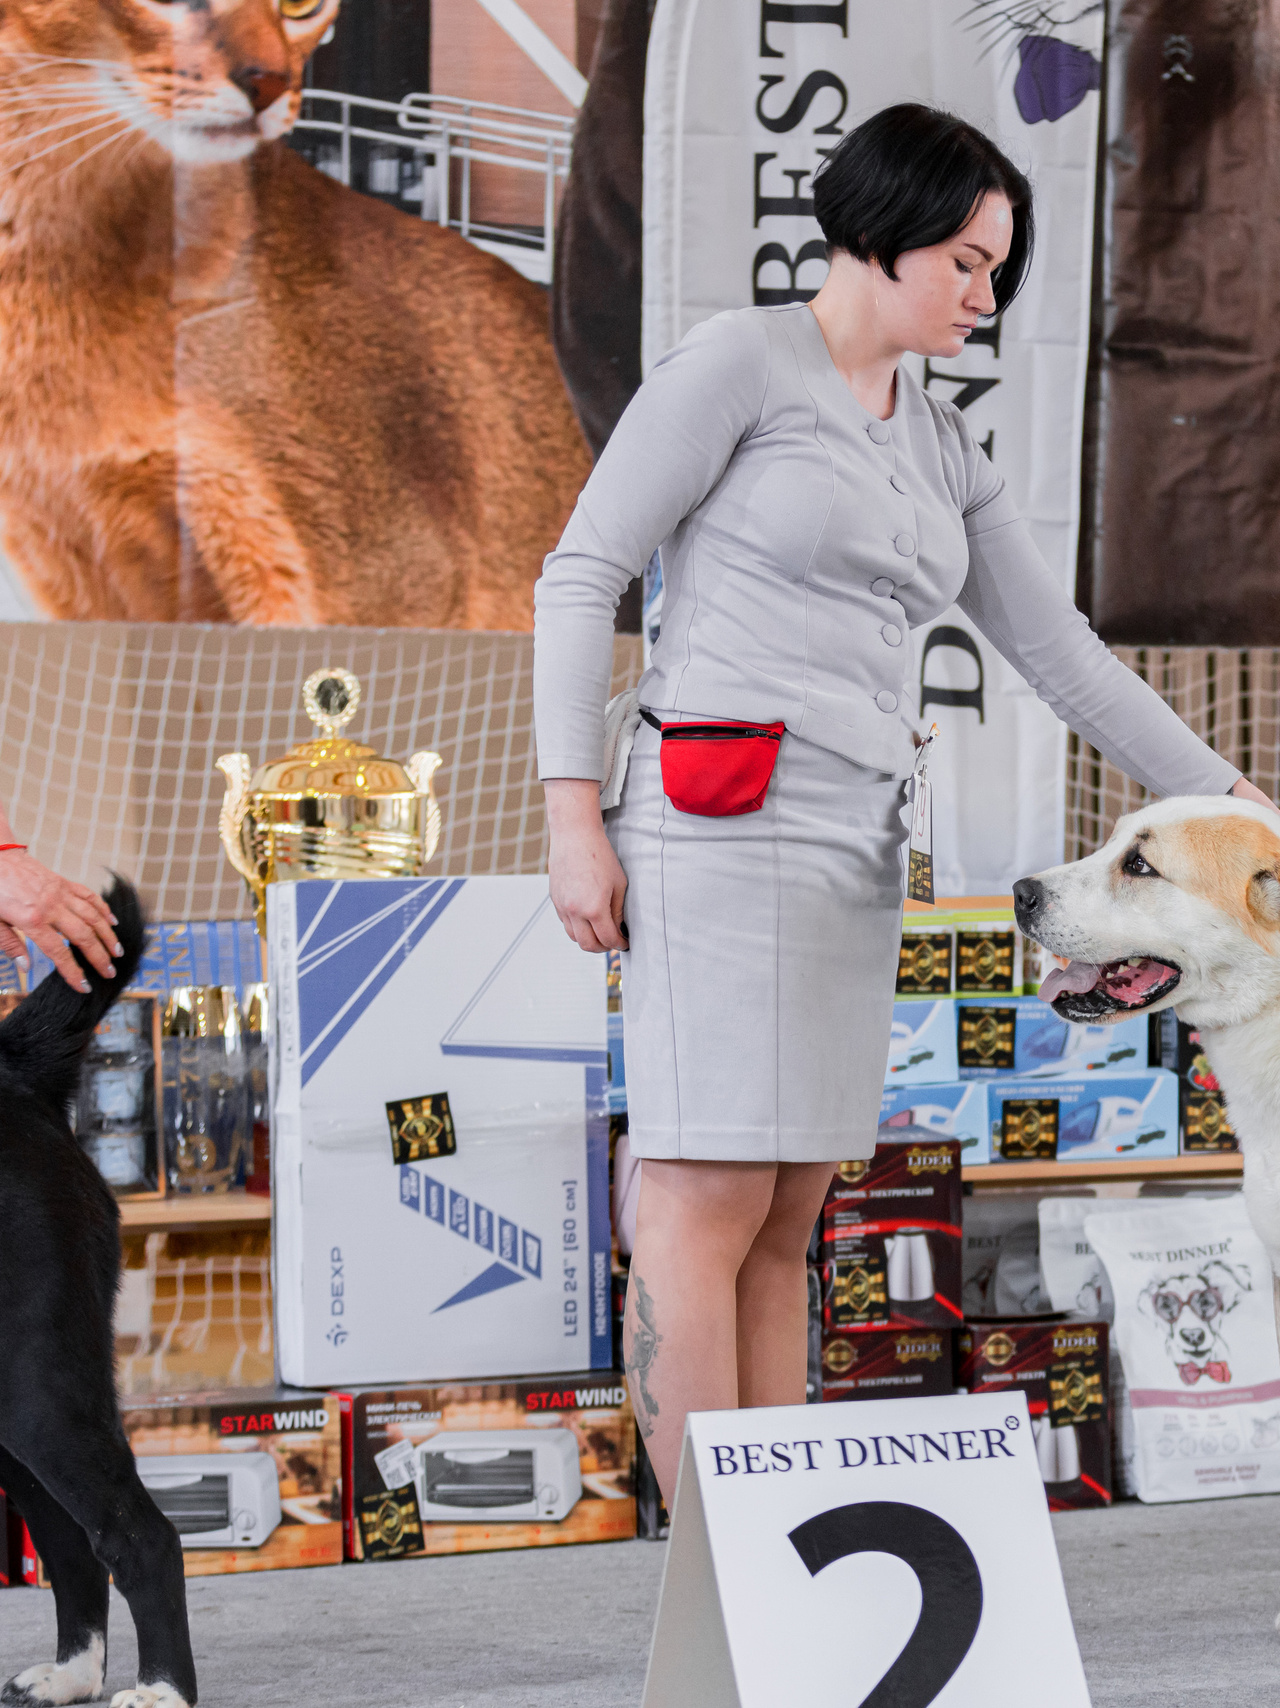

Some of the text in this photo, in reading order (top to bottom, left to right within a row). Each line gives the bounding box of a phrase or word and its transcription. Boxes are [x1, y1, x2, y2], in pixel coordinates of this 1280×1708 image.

[562, 1218, 578, 1251] [60
[1166, 1242, 1230, 1263] DINNER
[331, 1246, 345, 1317] DEXP
[564, 1299, 578, 1337] LED
[526, 1387, 627, 1411] STARWIND
[220, 1409, 330, 1435] STARWIND
[710, 1428, 1015, 1476] BEST DINNER
[787, 1500, 984, 1708] 2
